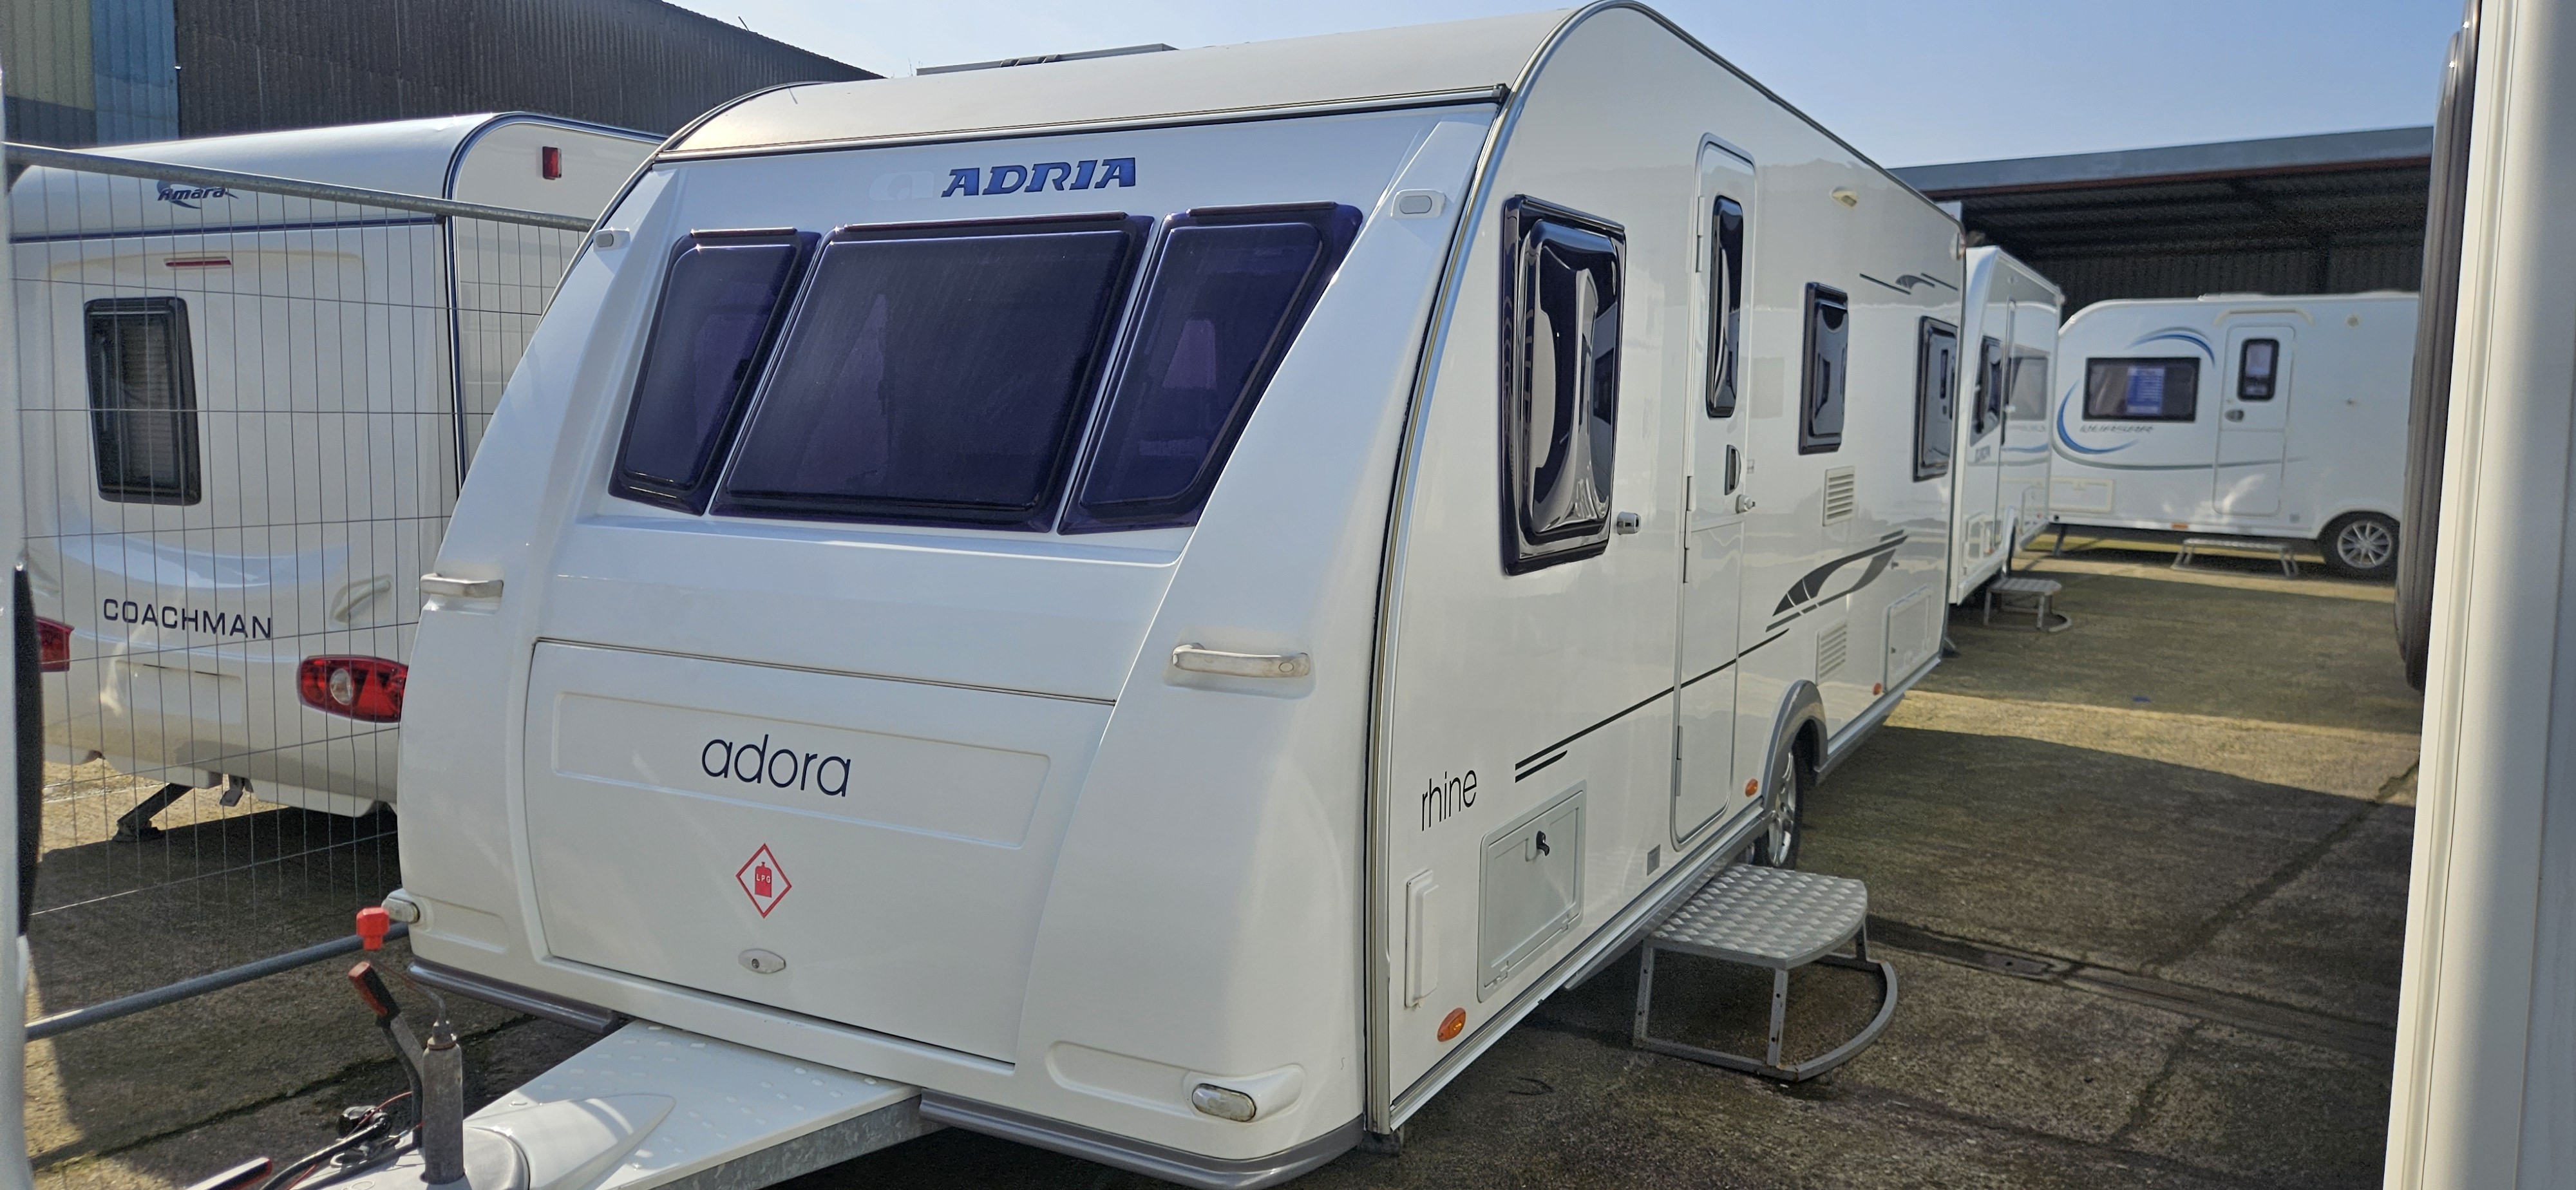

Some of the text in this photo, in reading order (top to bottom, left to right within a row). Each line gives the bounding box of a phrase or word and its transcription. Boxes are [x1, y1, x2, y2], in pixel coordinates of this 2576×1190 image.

[157, 187, 226, 201] Amara
[940, 157, 1136, 198] ADRIA
[103, 598, 272, 639] COACHMAN
[701, 733, 851, 798] adora
[1421, 770, 1477, 832] rhine
[756, 873, 771, 883] LPG
